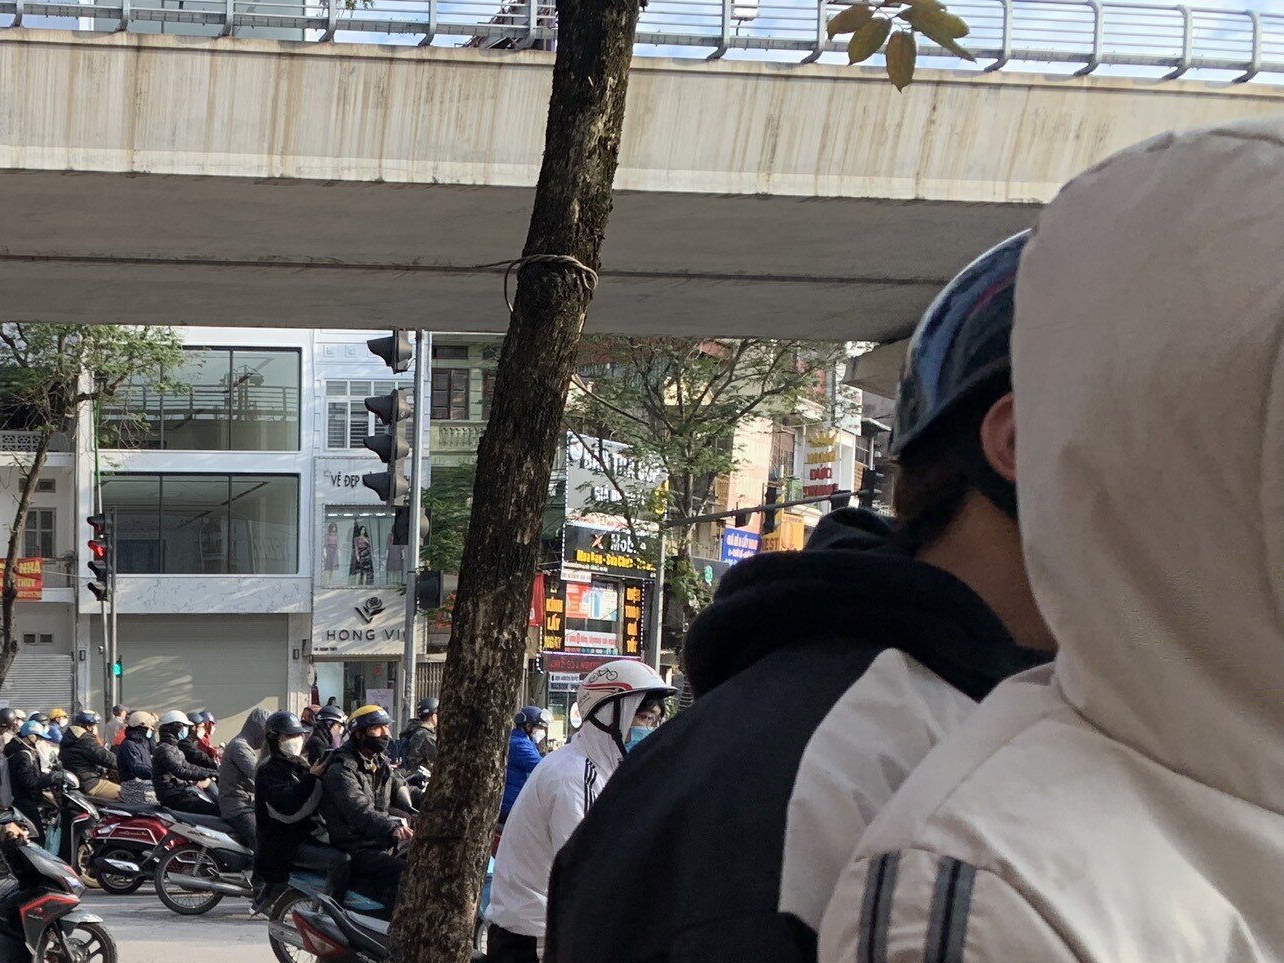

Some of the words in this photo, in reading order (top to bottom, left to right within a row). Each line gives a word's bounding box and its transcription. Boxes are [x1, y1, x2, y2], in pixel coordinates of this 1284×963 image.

[344, 474, 360, 489] ĐẸP
[327, 629, 376, 641] HONG
[384, 629, 405, 641] VI
